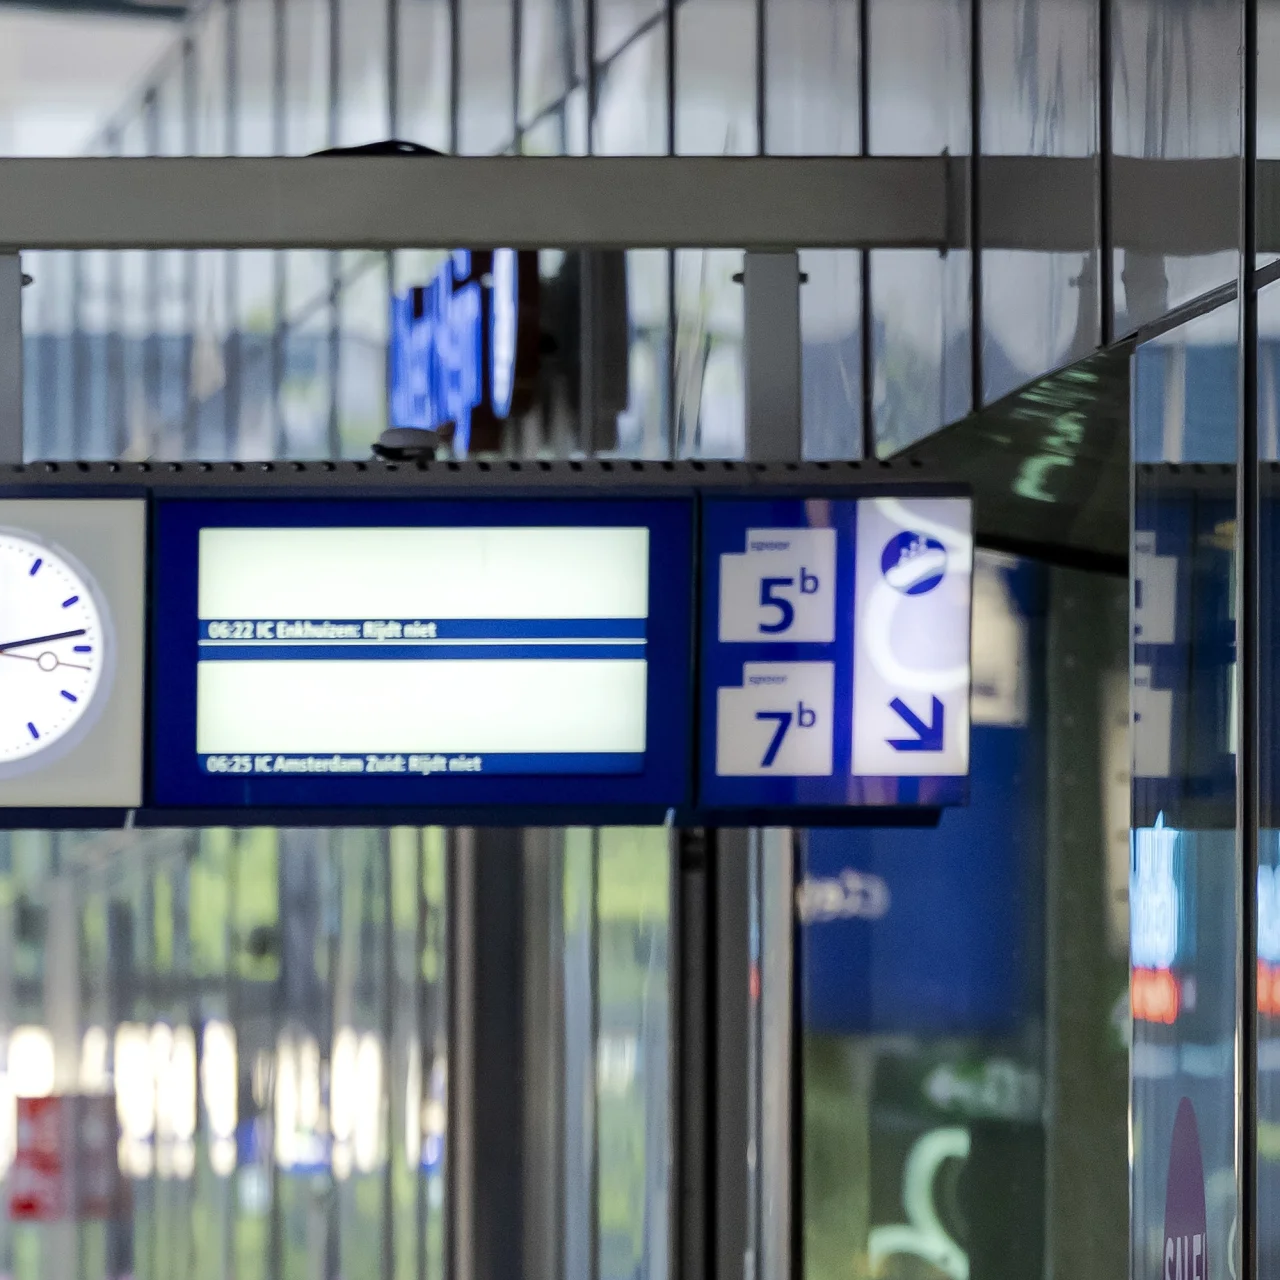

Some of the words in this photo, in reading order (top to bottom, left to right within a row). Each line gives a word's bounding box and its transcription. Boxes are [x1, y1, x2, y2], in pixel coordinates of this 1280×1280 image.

[208, 621, 254, 638] 06:22
[256, 621, 275, 638] IC
[276, 621, 361, 638] Enkhuizen:
[363, 621, 402, 641] Rijdt
[403, 620, 437, 638] niet
[206, 755, 252, 773] 06:25
[254, 755, 273, 773] IC
[273, 755, 364, 773] Amsterdam
[366, 755, 406, 773] Zuid:
[408, 755, 448, 776] Rijdt
[449, 754, 482, 773] niet
